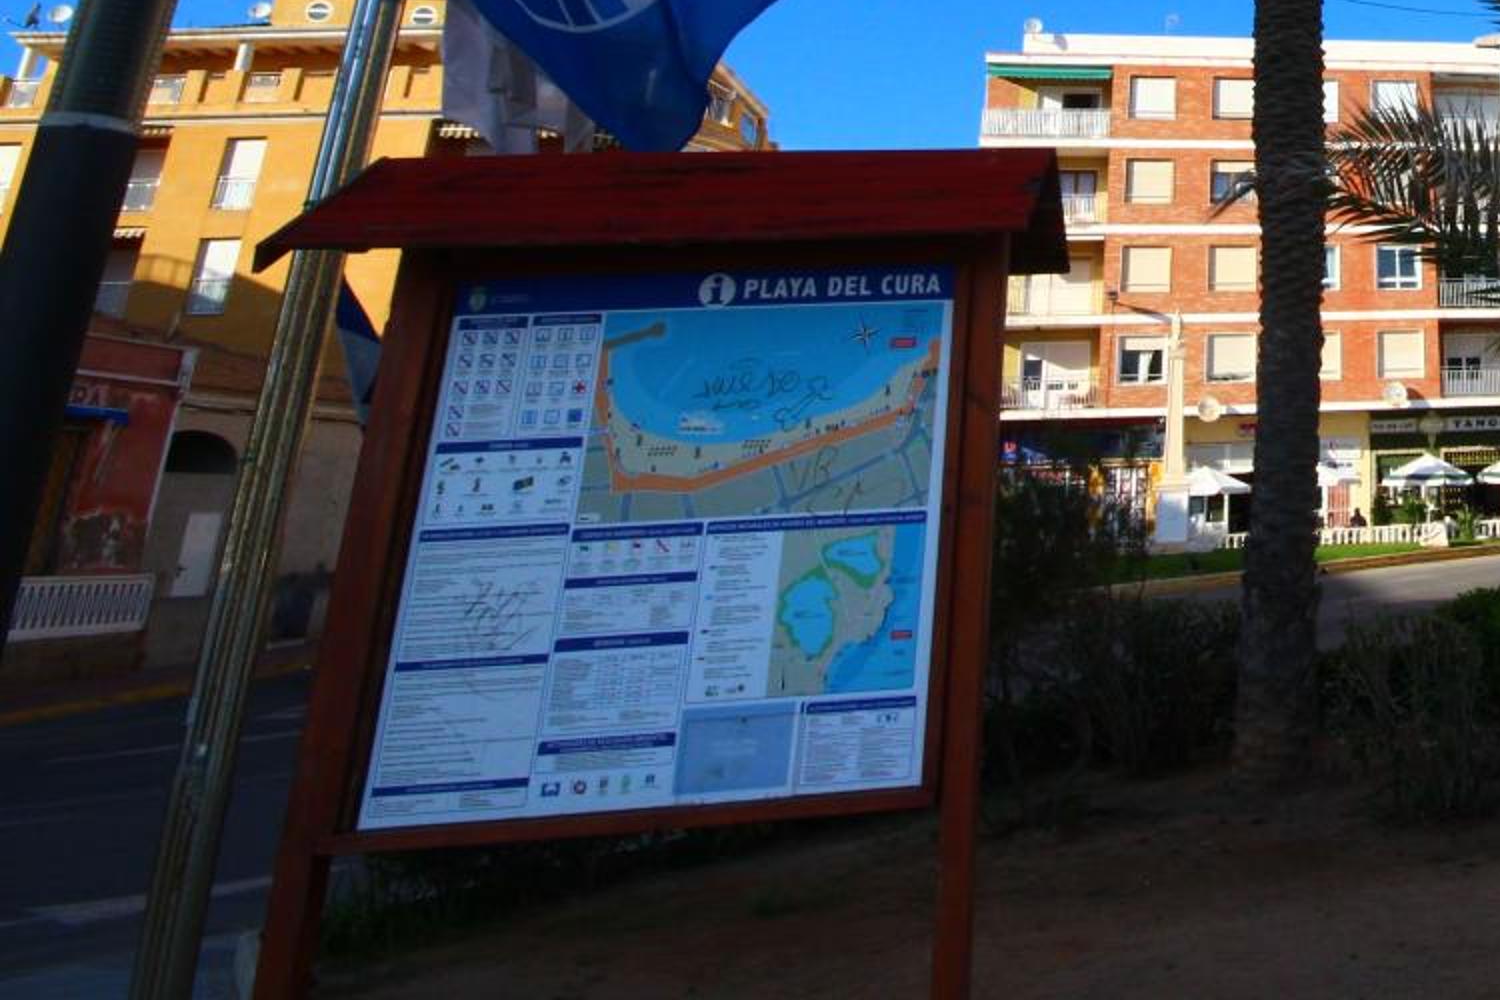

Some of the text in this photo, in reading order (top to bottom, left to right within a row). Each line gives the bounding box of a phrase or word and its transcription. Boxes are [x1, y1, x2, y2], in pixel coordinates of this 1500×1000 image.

[743, 277, 817, 299] PLAYA
[827, 275, 872, 297] DEL
[881, 273, 942, 296] CURA
